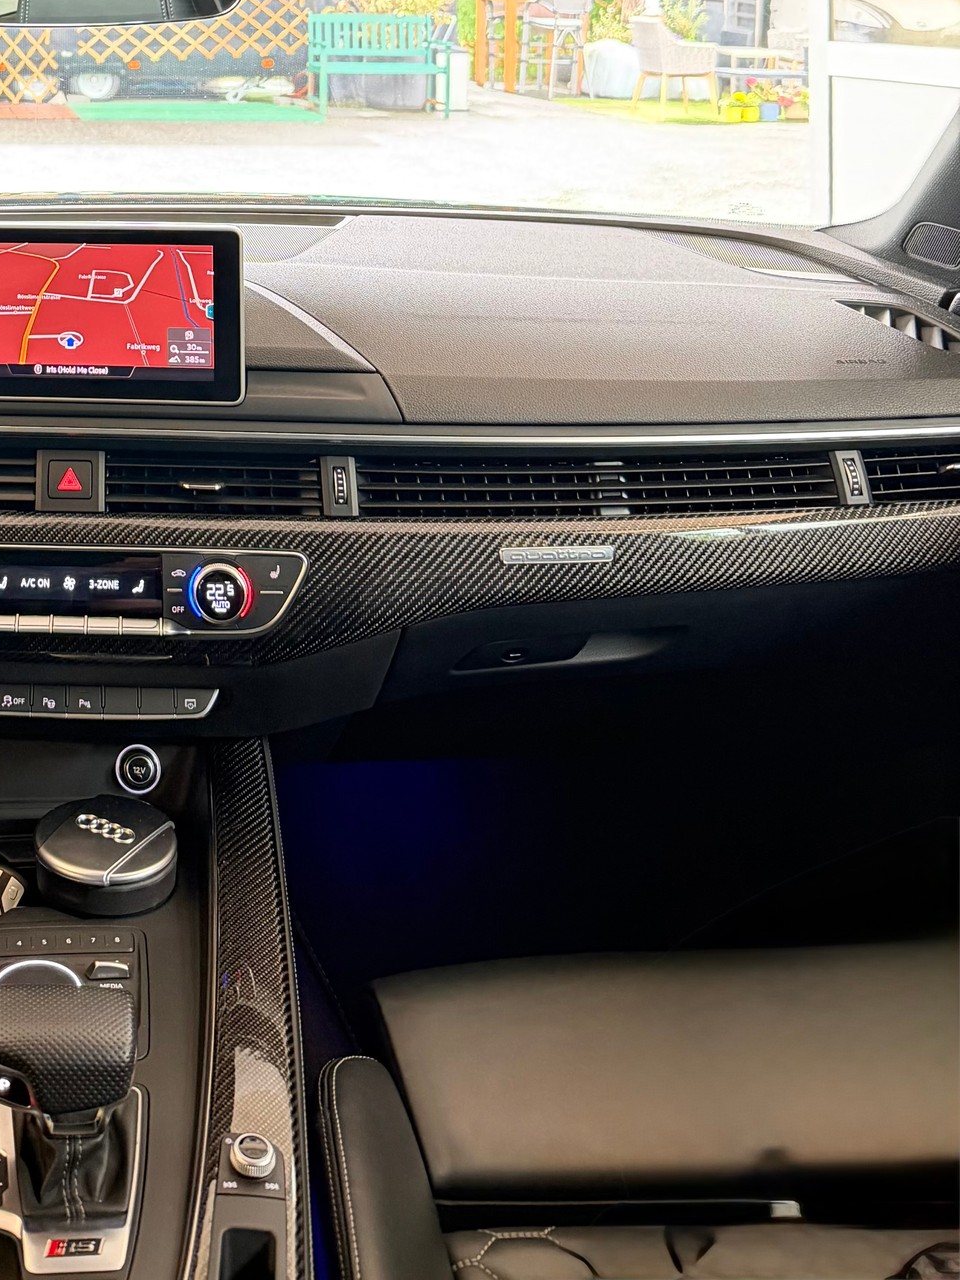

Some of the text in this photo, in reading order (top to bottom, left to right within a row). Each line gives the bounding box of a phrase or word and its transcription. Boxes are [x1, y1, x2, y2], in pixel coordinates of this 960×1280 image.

[126, 342, 161, 352] Fabrikweg
[46, 365, 109, 376] Iris (Hold Me Close)
[20, 578, 51, 590] A/C ON
[88, 578, 120, 590] 3-ZONE
[205, 582, 235, 602] 22.5
[170, 604, 185, 614] OFF
[211, 599, 230, 610] AUTO
[12, 696, 26, 705] OFF
[132, 766, 146, 776] 12V
